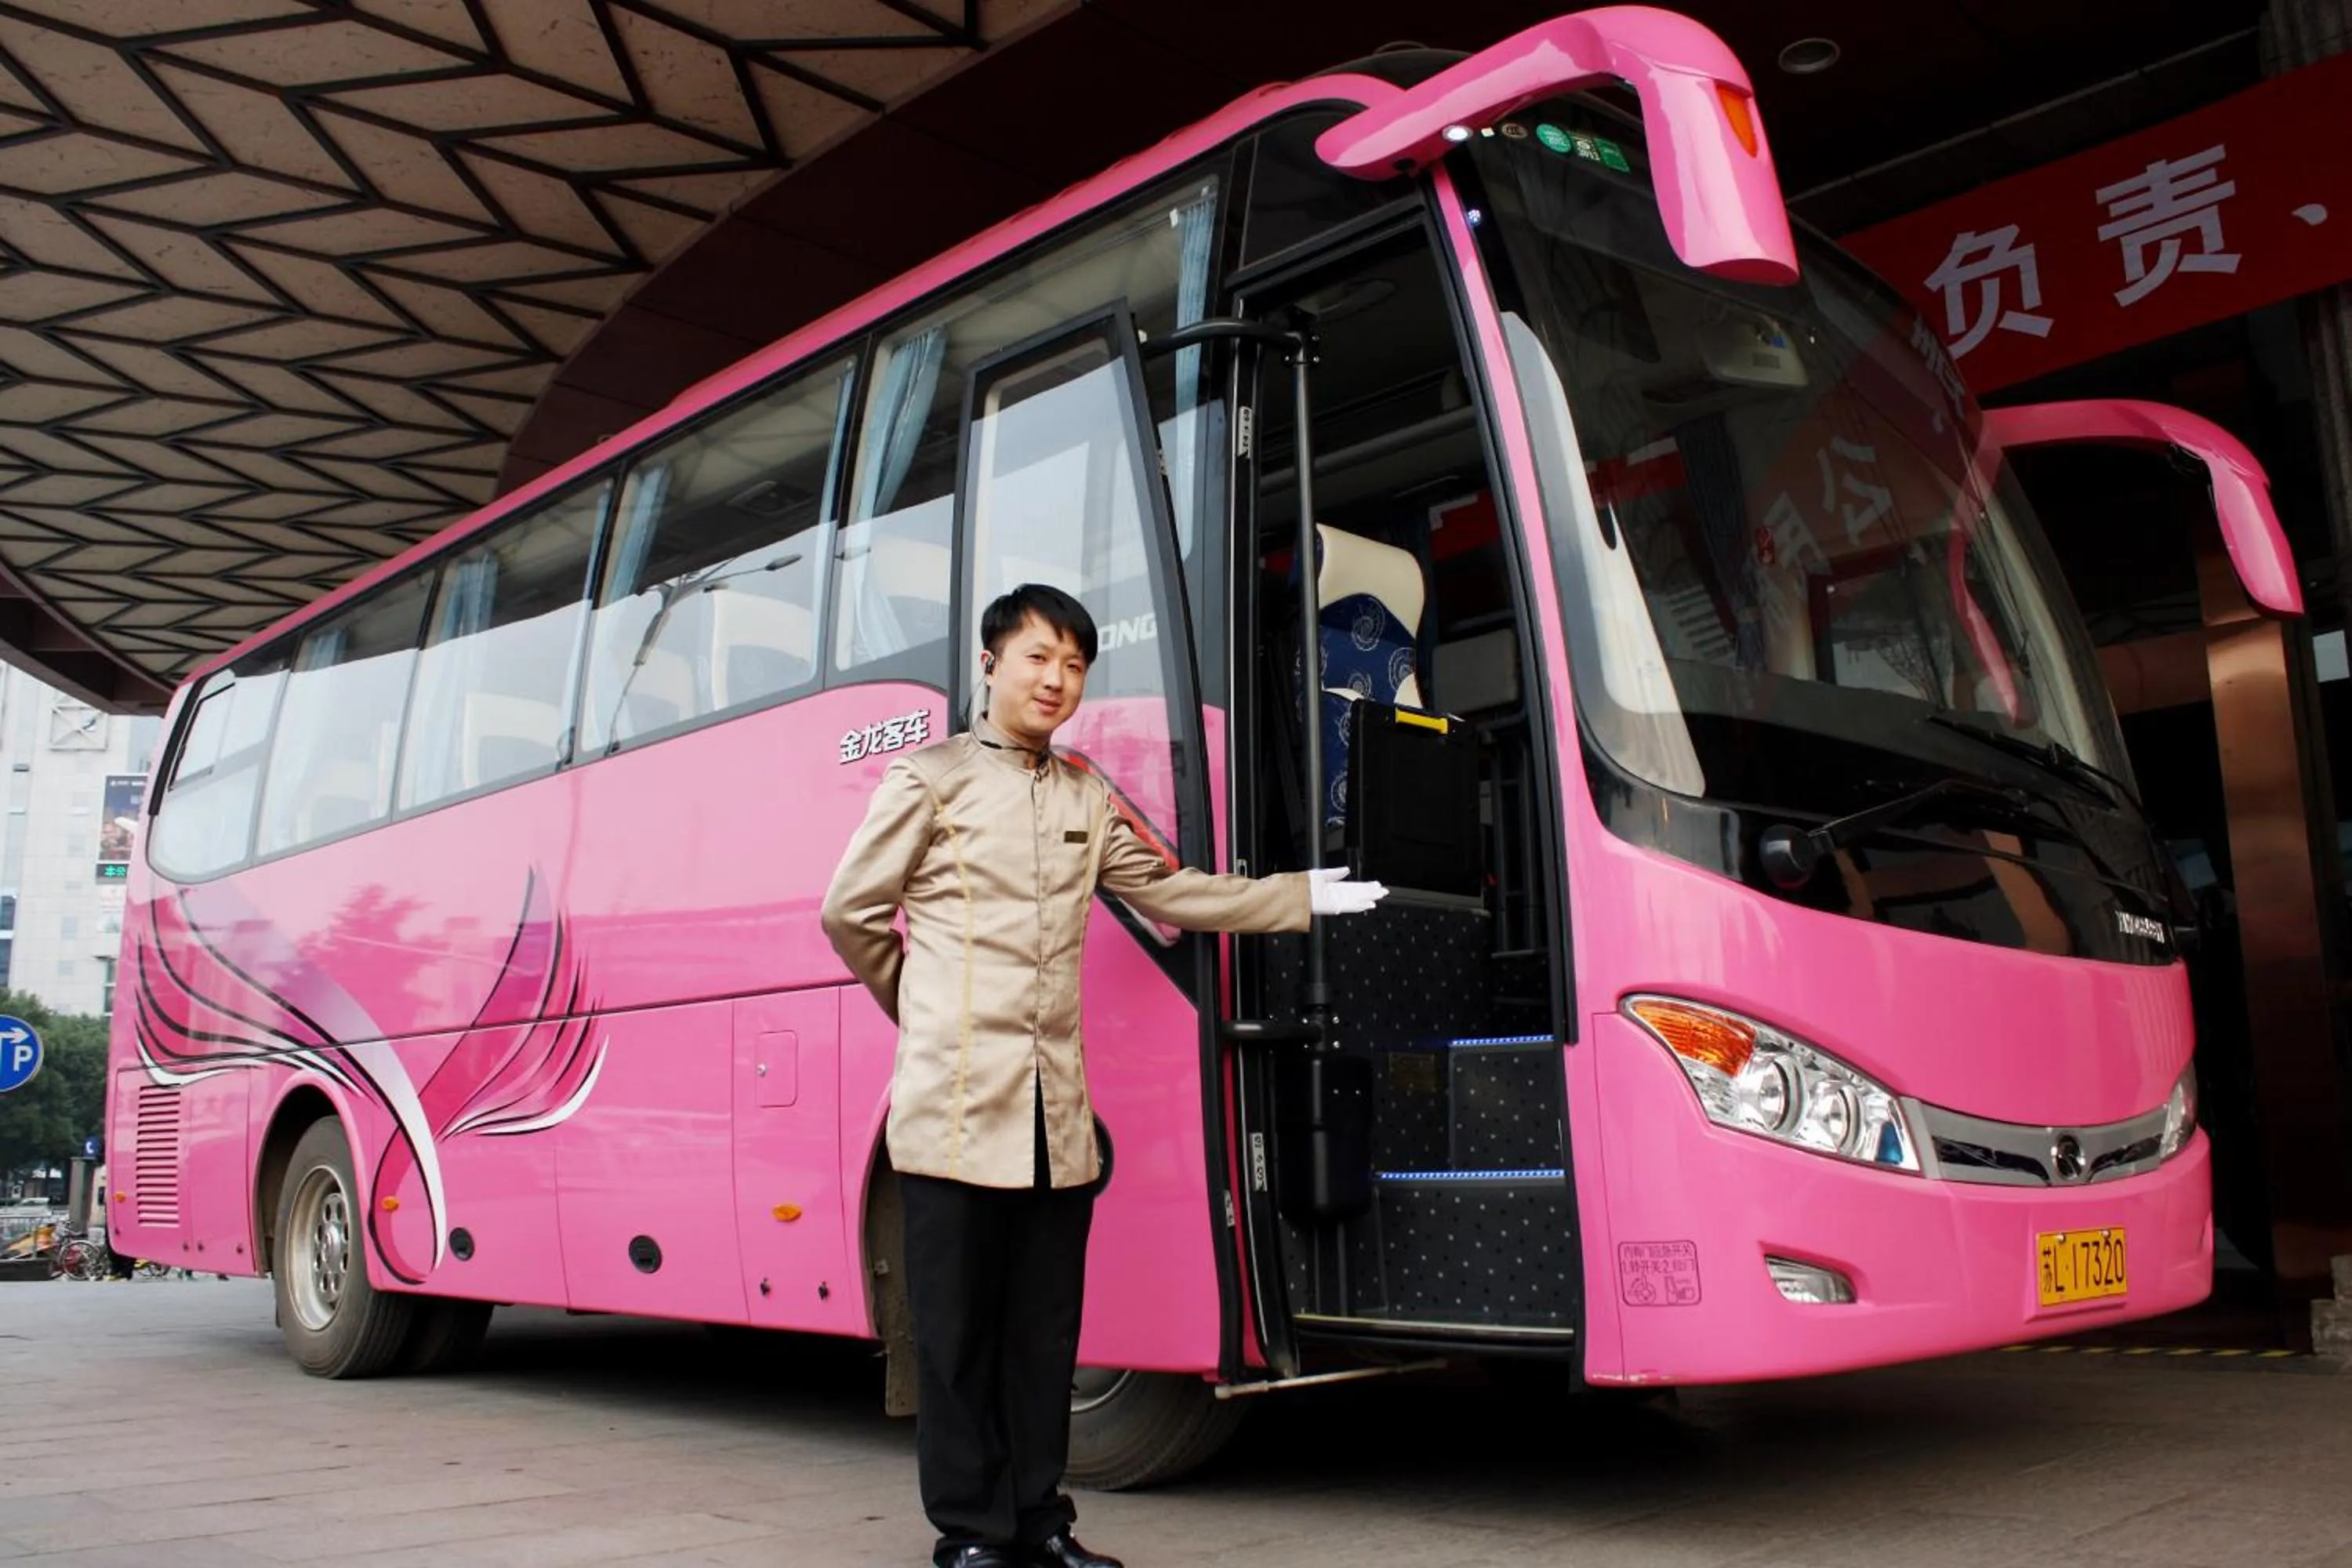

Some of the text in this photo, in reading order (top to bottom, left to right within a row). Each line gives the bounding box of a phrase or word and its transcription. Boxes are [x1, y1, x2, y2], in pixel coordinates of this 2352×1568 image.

[840, 709, 931, 764] 金龙客车
[13, 1045, 33, 1072] P
